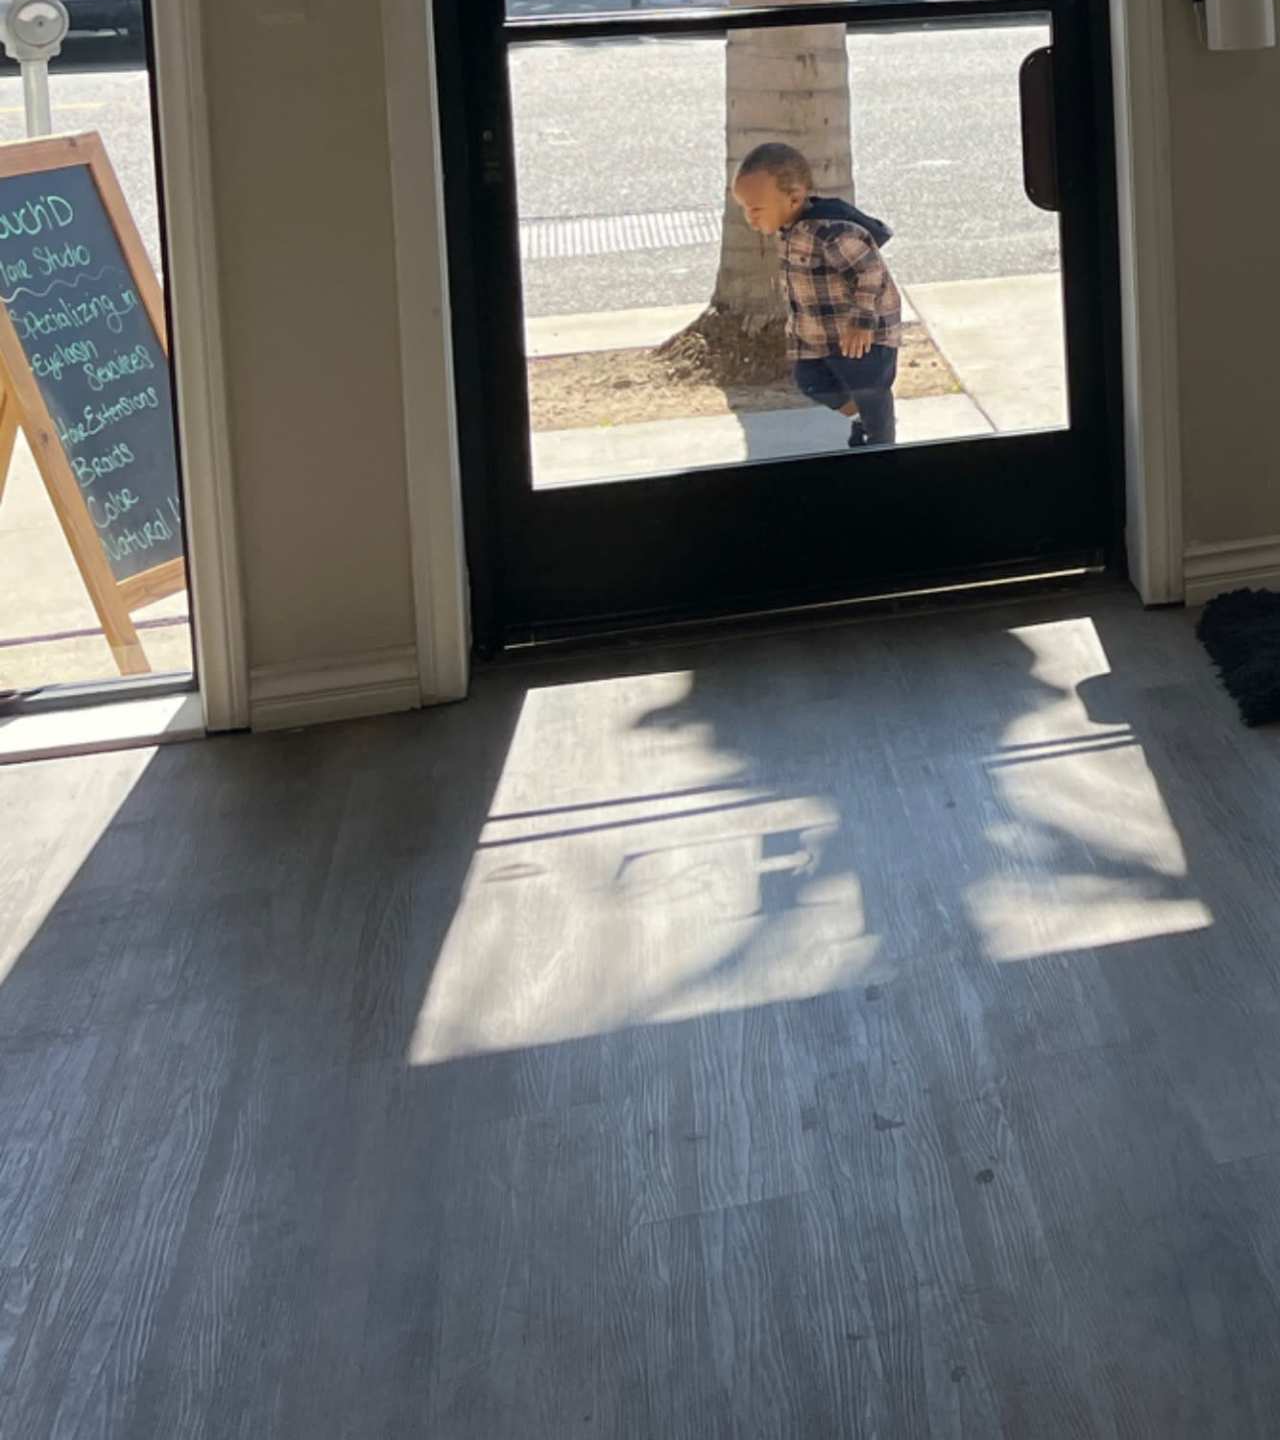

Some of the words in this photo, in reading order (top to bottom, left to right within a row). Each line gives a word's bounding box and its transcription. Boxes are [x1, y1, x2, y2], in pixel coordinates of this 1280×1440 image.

[32, 242, 91, 276] Studio
[8, 296, 123, 340] Specializing
[31, 339, 99, 380] Eyelash
